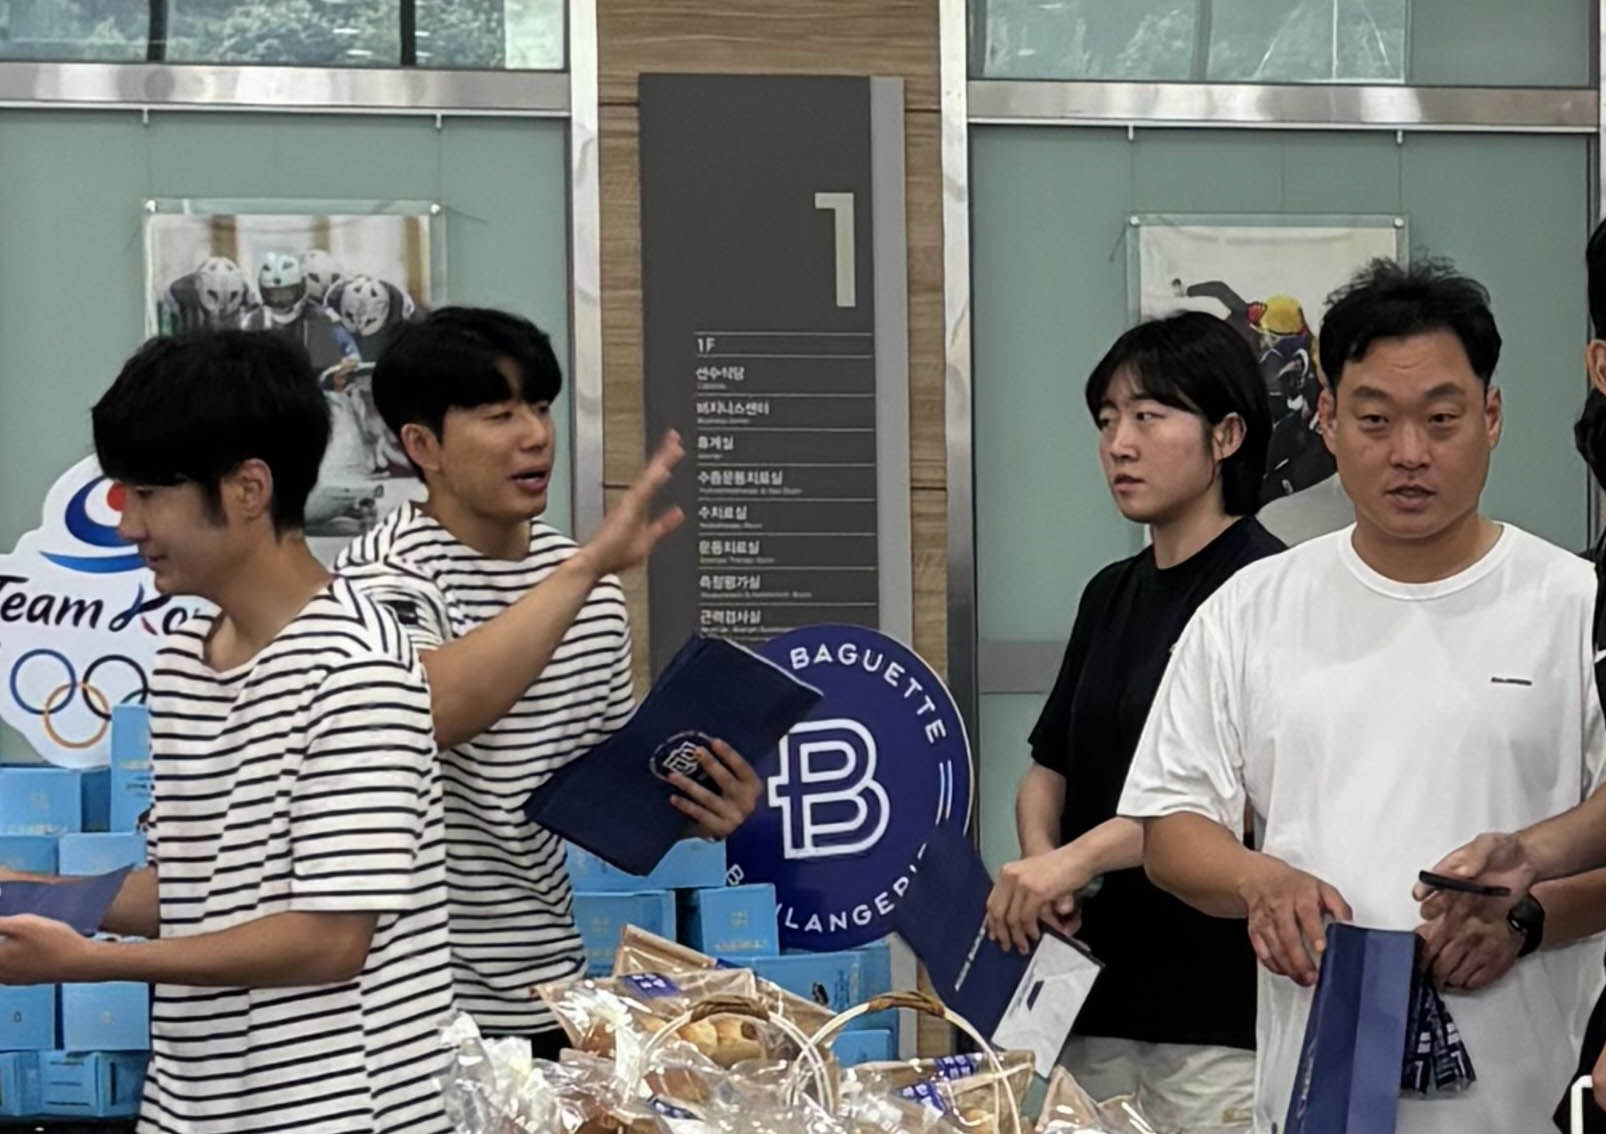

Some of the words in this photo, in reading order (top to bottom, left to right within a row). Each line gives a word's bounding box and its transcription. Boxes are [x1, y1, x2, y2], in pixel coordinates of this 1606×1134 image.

[814, 192, 857, 307] 1
[697, 337, 716, 352] 1F
[696, 366, 745, 381] 선수식당
[698, 506, 747, 520] 수치료실
[699, 540, 760, 555] 운동치료실
[109, 582, 200, 636] Ko
[790, 642, 947, 745] BAGUETTE
[768, 718, 891, 860] B
